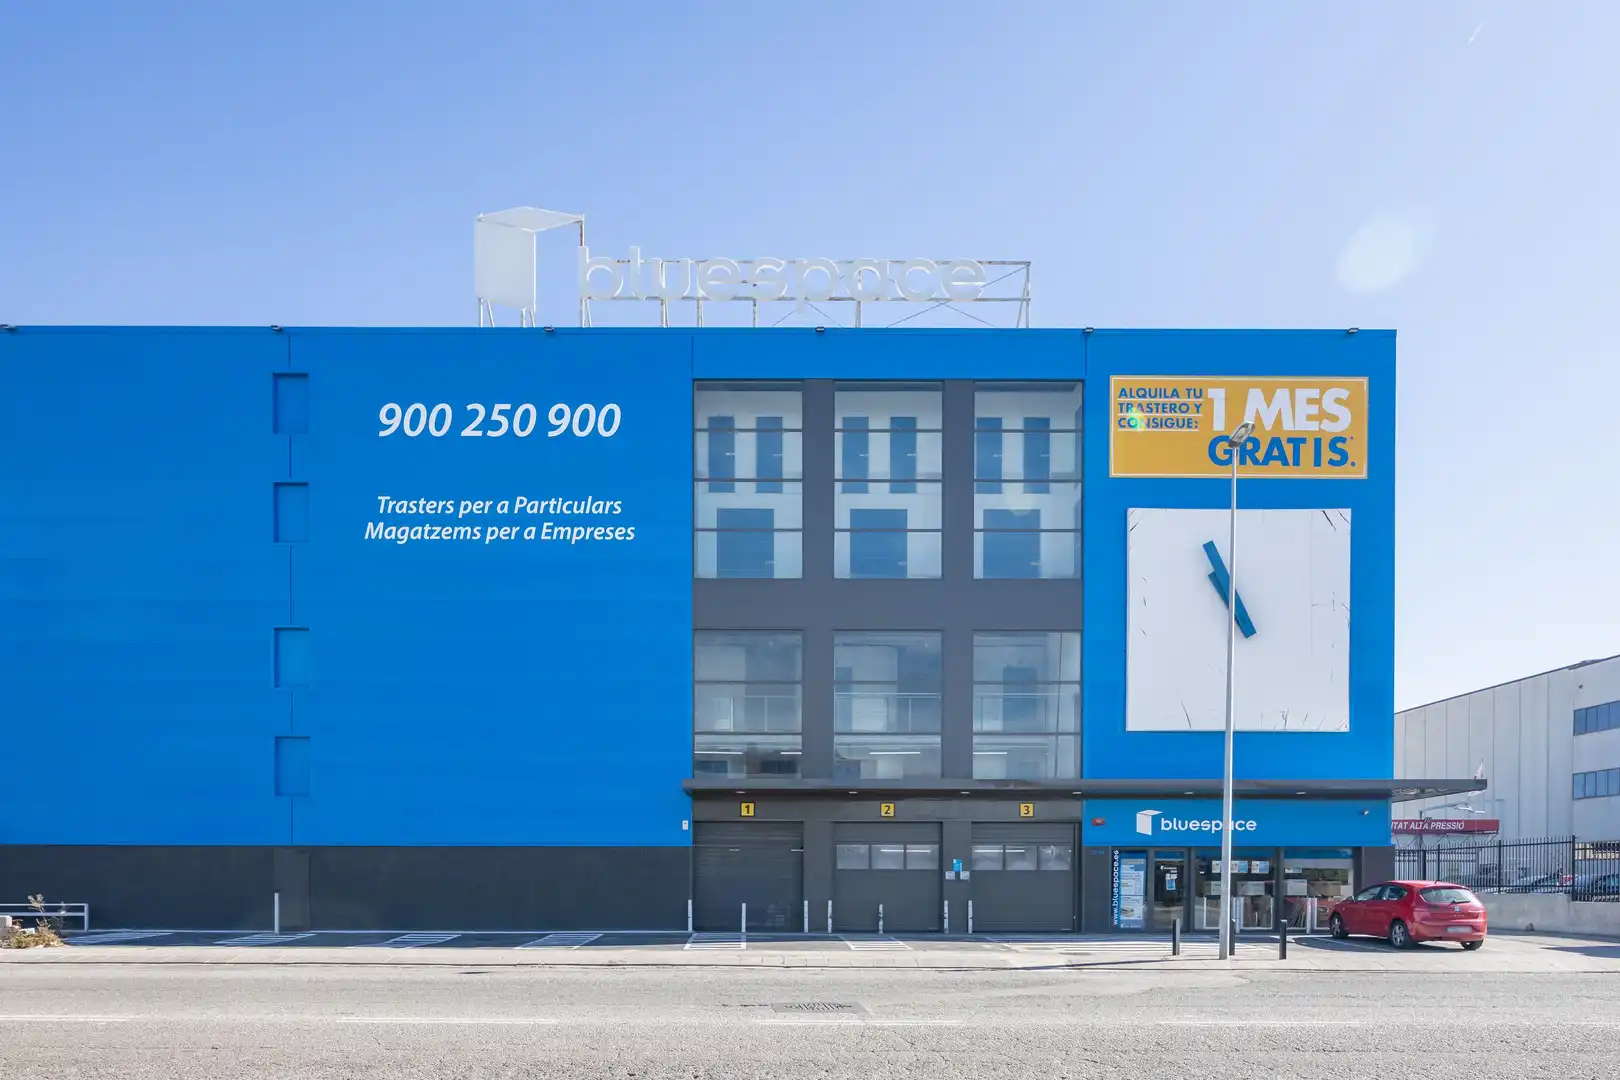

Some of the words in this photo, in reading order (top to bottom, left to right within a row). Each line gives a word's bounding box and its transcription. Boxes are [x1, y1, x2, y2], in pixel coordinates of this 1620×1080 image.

[578, 245, 987, 313] bluespace
[1117, 387, 1181, 399] ALQUILA
[1184, 387, 1203, 399] TU
[1117, 402, 1190, 414] TRASTERO
[1193, 402, 1203, 414] Y
[1207, 387, 1226, 431] 1
[1243, 387, 1352, 433] MES
[378, 402, 453, 437] 900
[460, 402, 537, 437] 250
[547, 402, 622, 437] 900
[1117, 416, 1199, 429] CONSIGUE:
[377, 496, 455, 514] Trasters
[458, 499, 493, 518] per
[496, 499, 509, 514] a
[514, 496, 622, 514] Particulars
[364, 522, 481, 544] Magatzems
[485, 525, 519, 544] per
[523, 525, 537, 540] a
[541, 522, 636, 544] Empreses
[744, 804, 751, 815] 1
[884, 804, 891, 815] 2
[1023, 805, 1030, 815] 3
[1409, 821, 1429, 830] ALTA
[1112, 849, 1120, 926] www.bluespace.es
